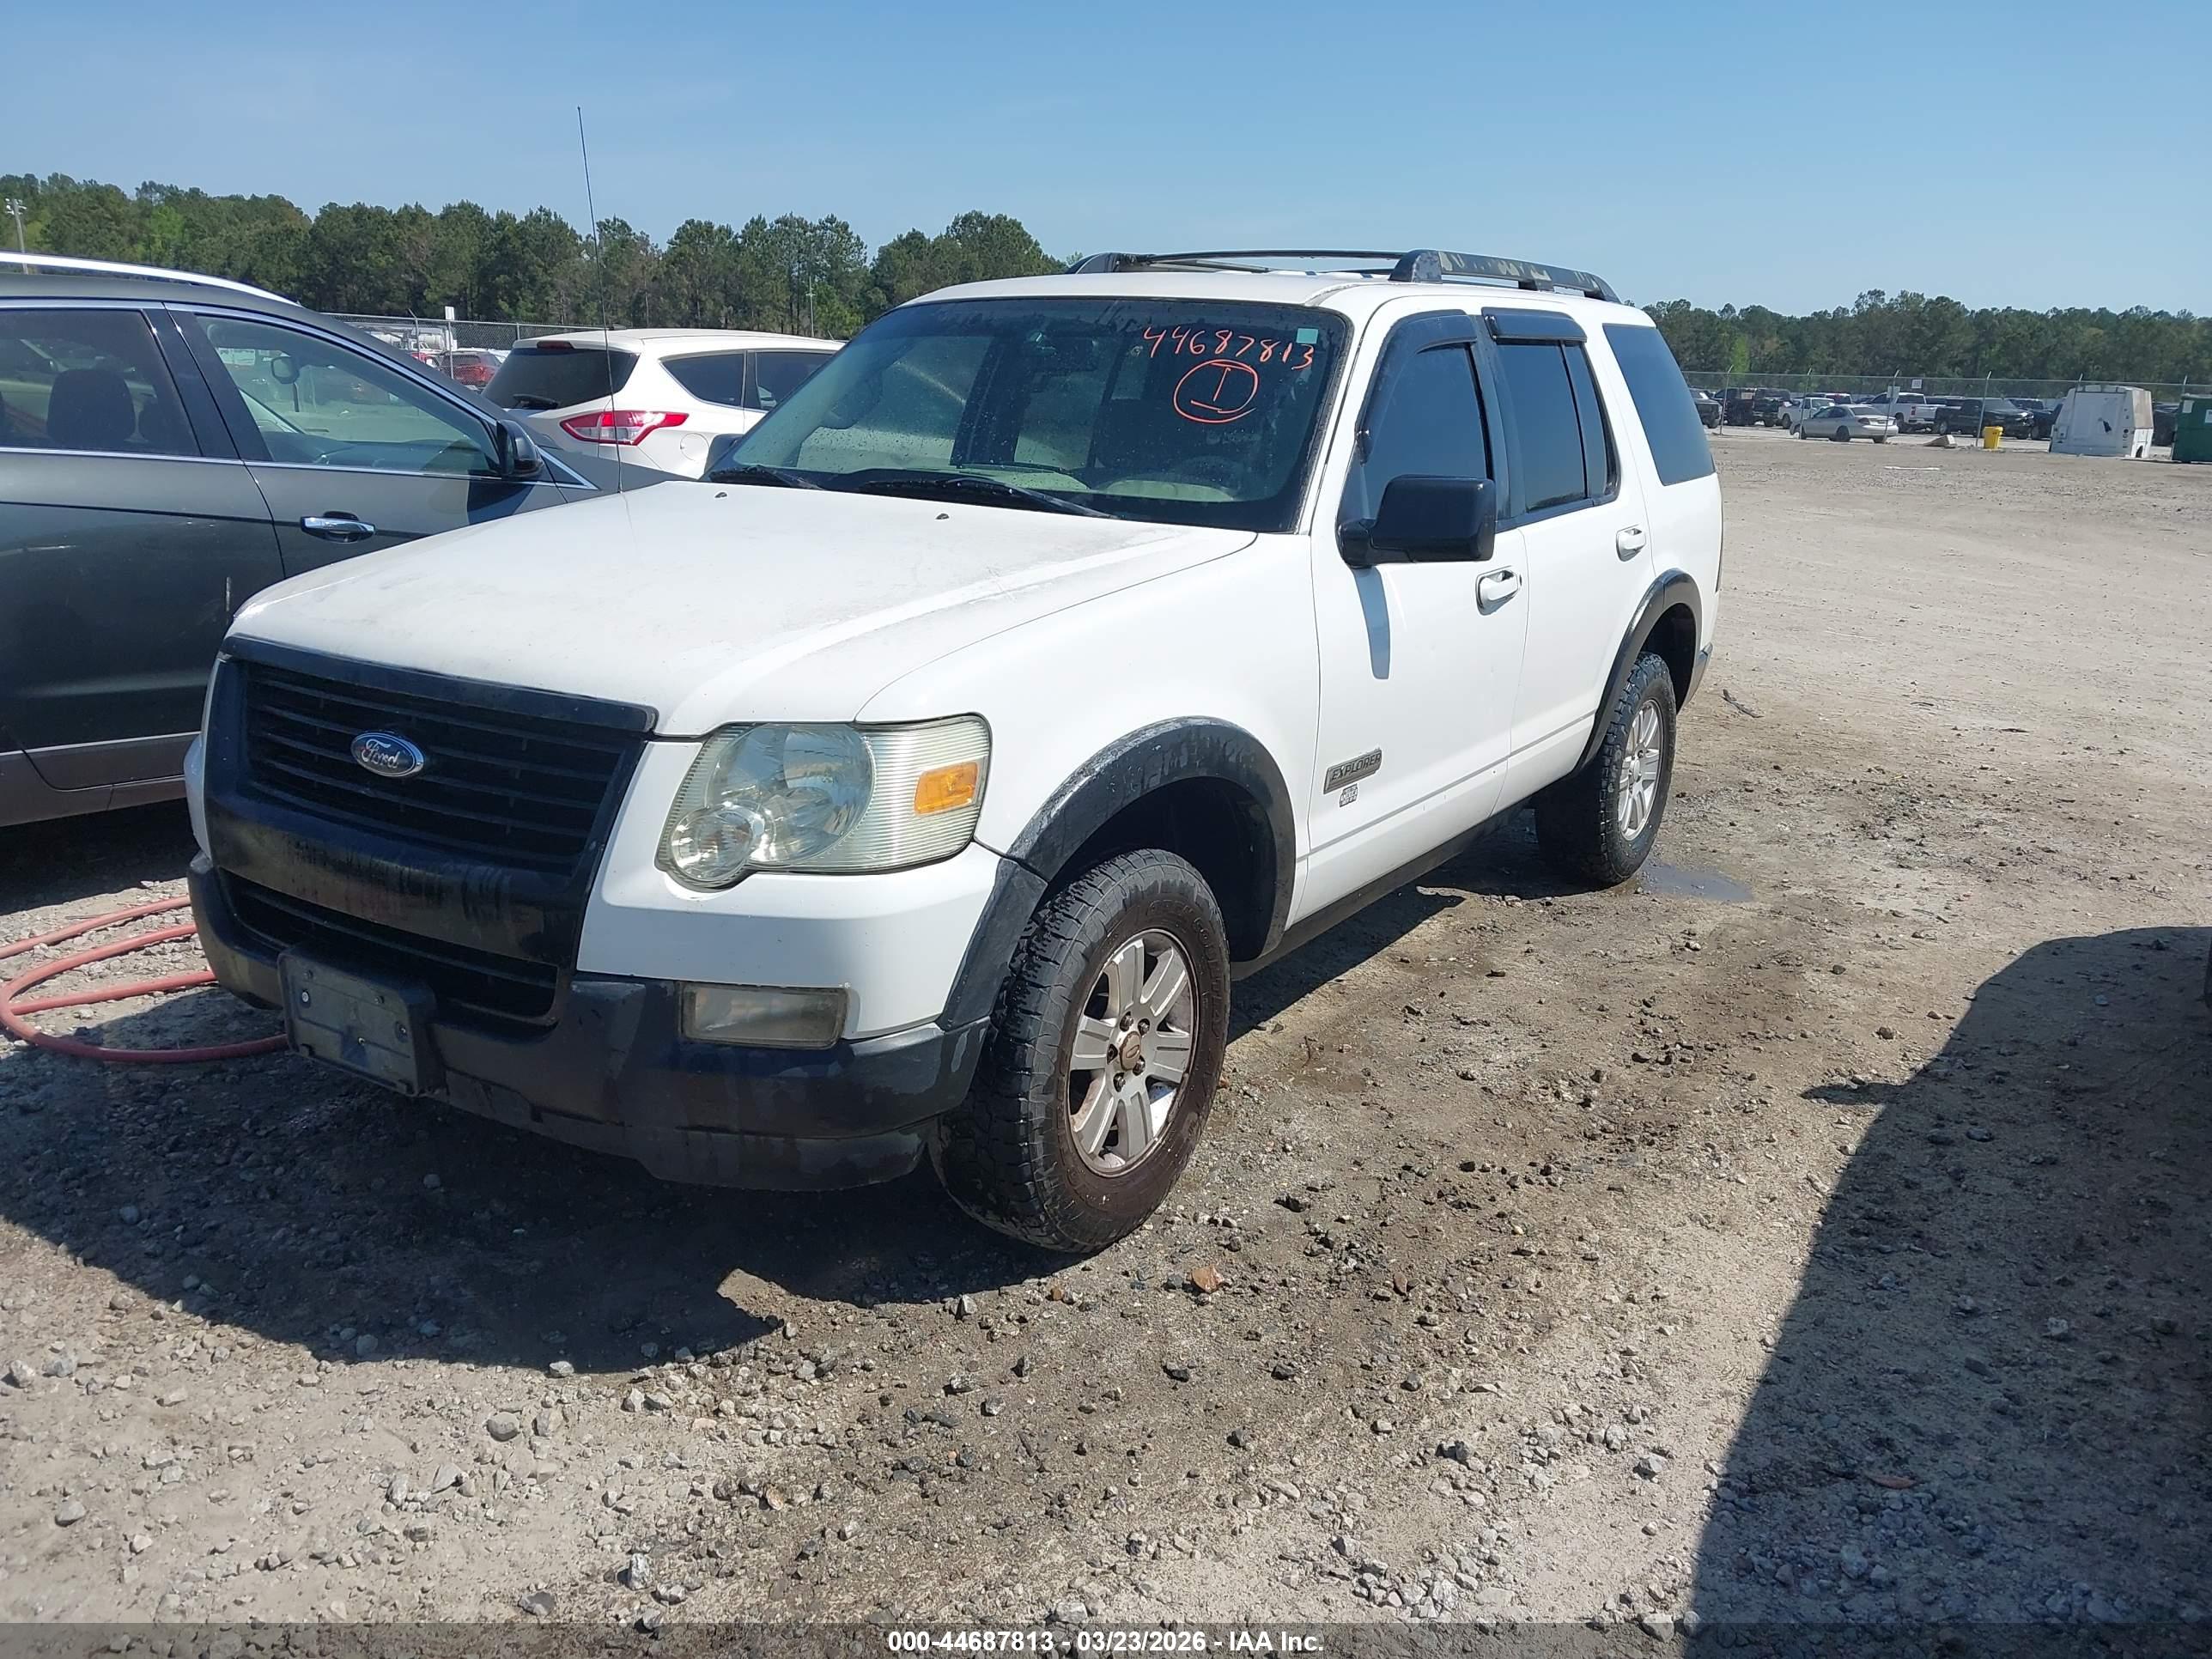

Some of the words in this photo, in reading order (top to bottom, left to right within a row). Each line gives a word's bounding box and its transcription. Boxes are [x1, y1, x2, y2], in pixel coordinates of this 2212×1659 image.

[1143, 325, 1315, 370] 44687813
[361, 738, 400, 769] Ford
[1331, 752, 1381, 781] EXPLORER
